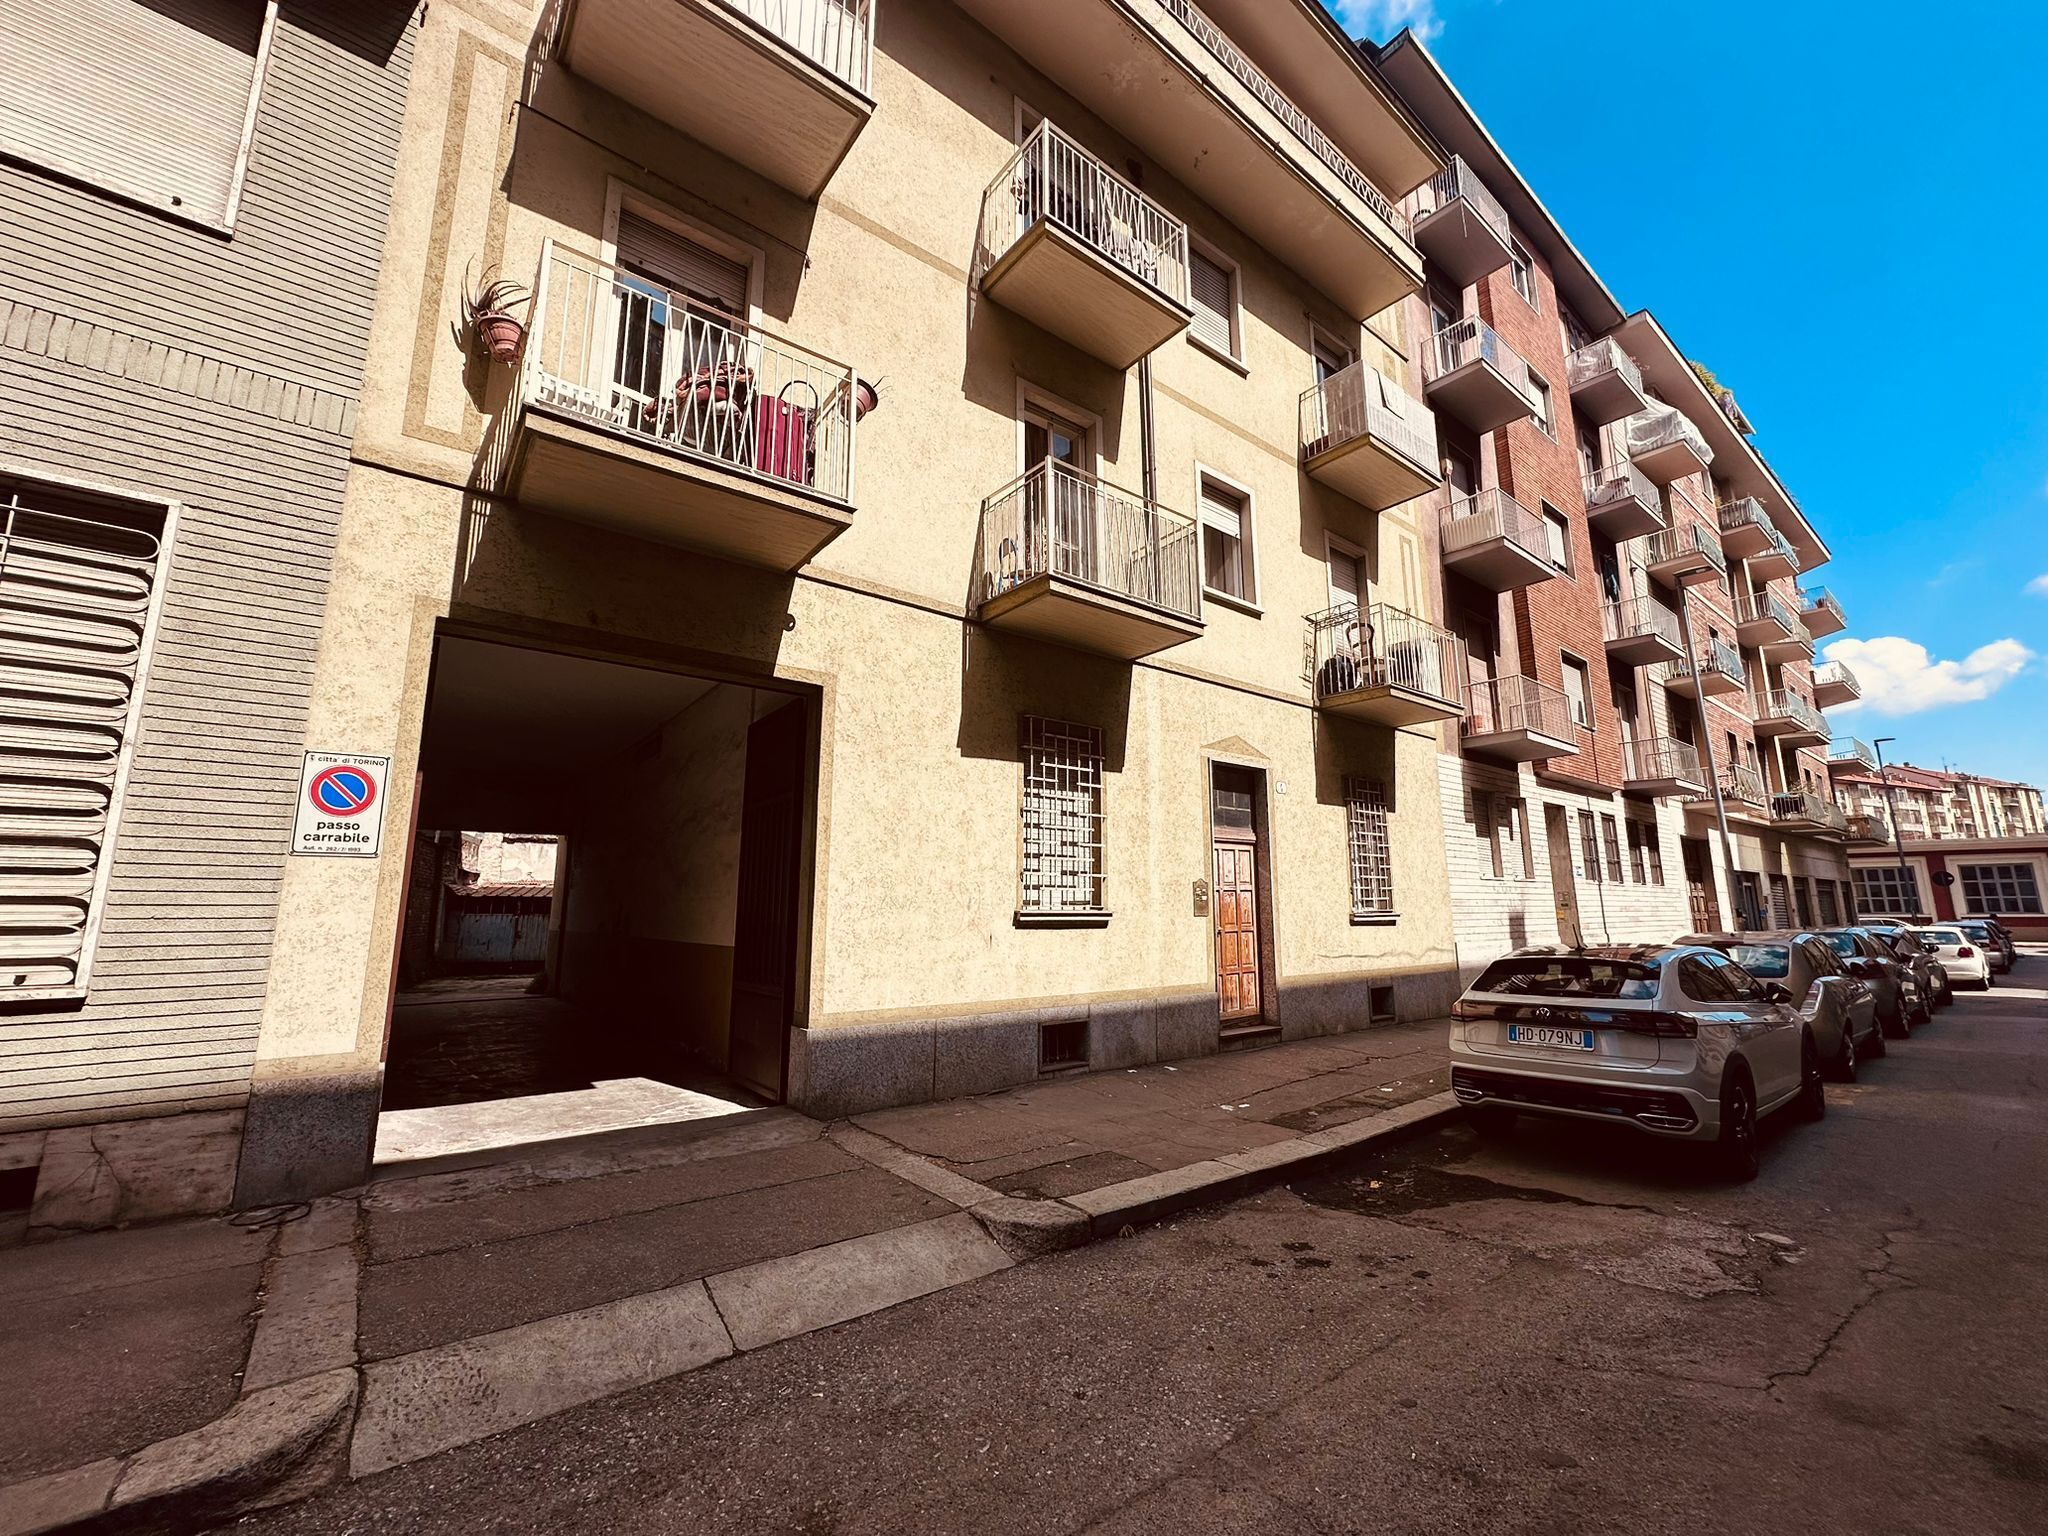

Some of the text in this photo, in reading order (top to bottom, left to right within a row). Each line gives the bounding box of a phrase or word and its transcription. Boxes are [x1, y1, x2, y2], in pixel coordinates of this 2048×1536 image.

[353, 759, 385, 767] TORINO
[317, 821, 360, 830] passo
[303, 833, 370, 843] carrabile
